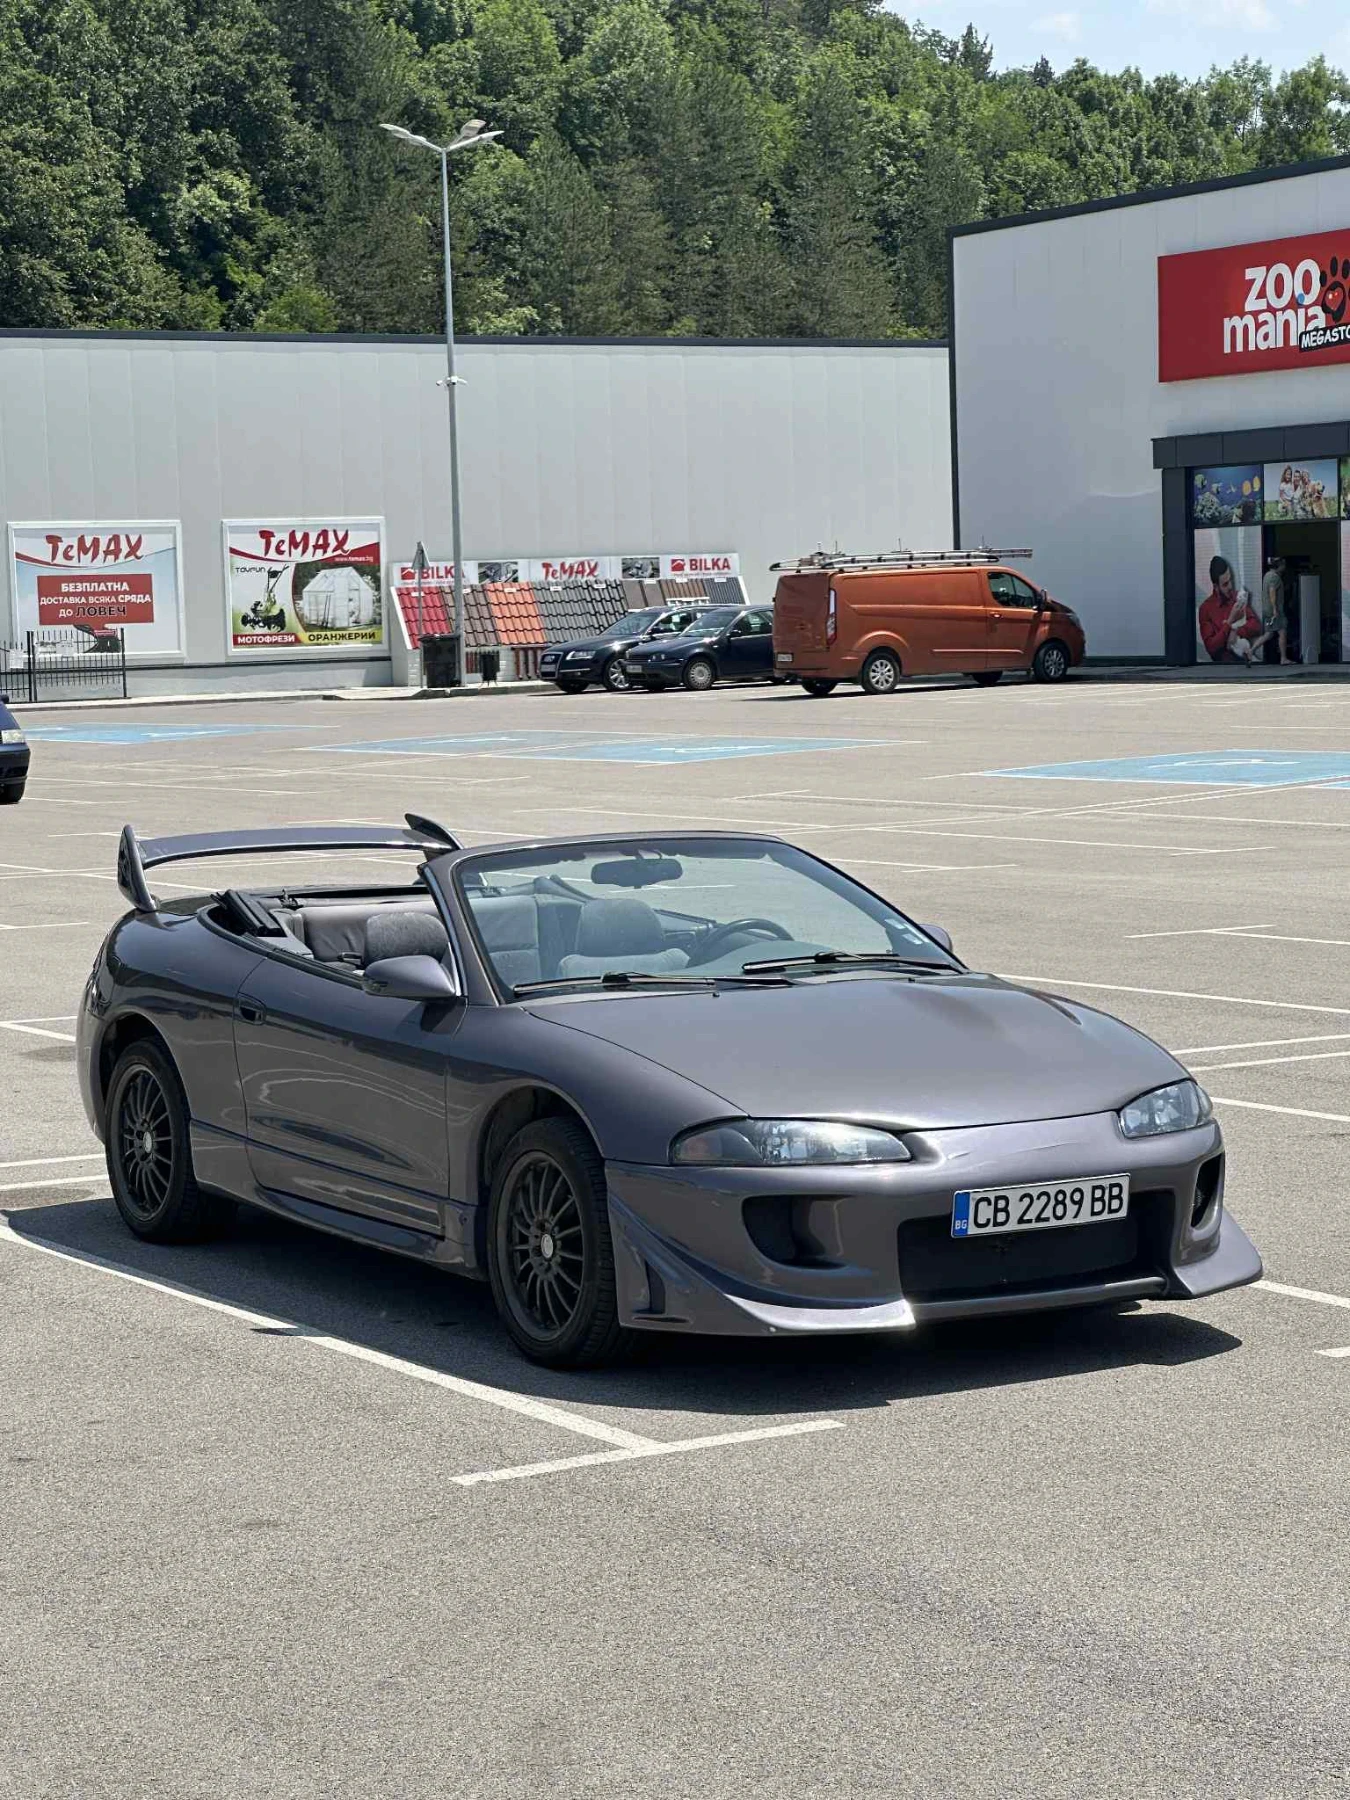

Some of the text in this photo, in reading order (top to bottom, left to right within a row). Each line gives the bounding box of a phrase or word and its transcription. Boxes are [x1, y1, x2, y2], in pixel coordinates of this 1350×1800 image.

[1223, 305, 1326, 354] mania
[45, 534, 144, 563] TeMAX
[258, 529, 349, 557] TeMAX
[541, 560, 600, 580] TeMAX
[688, 557, 731, 571] BILKA
[421, 565, 466, 580] BILK
[61, 582, 130, 593] БЕЗПЛАТНА
[40, 594, 152, 606] ДОСТАВКА ВСЯКА СРЯДА
[59, 605, 127, 618] ДО ЛОВЕЧ
[237, 635, 296, 645] МОТОФРЕЗИ
[308, 632, 376, 643] ОРАНЖЕРИИ
[1017, 1187, 1084, 1225] 2289
[955, 1219, 967, 1230] BG
